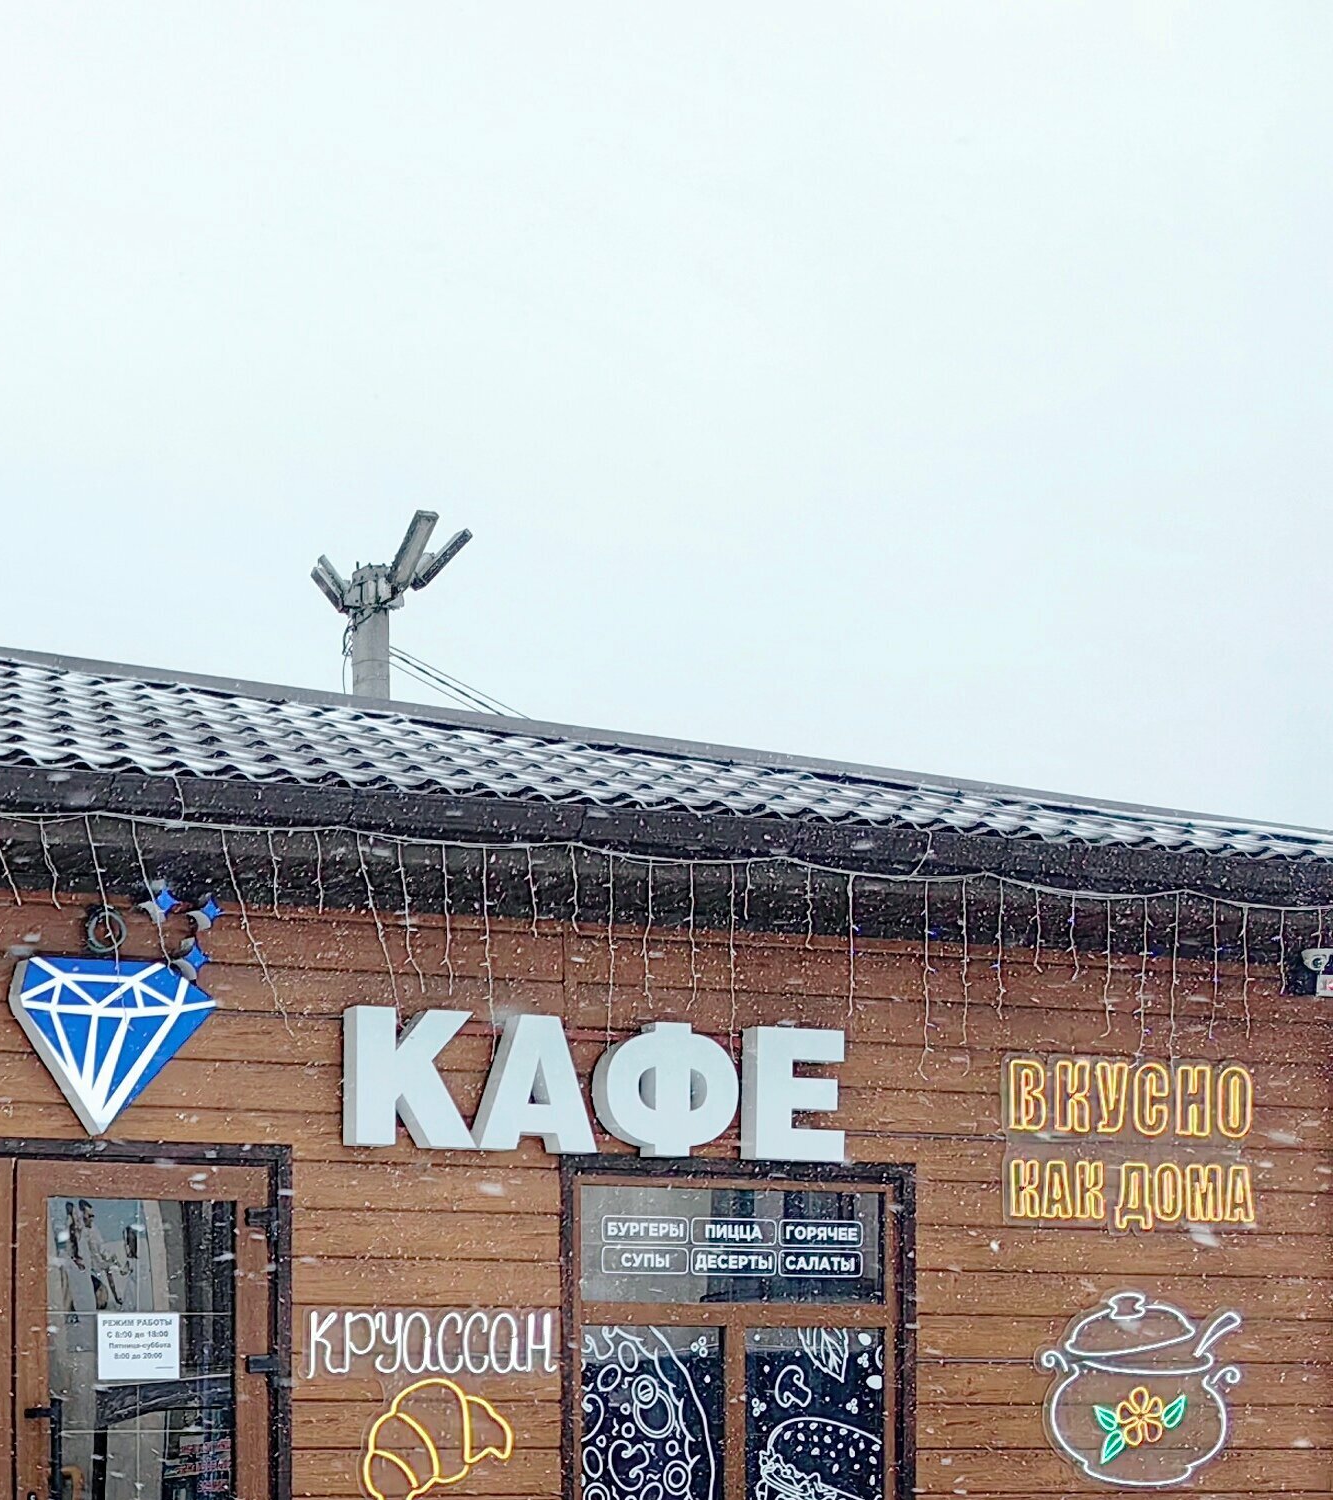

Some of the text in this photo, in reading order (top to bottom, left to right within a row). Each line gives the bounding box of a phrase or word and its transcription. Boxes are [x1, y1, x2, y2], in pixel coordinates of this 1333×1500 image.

[342, 1004, 846, 1163] КАФЕ
[1008, 1059, 1253, 1138] ВКУСНО
[1009, 1159, 1255, 1231] КАК ДОМА
[606, 1221, 684, 1238] БУРГЕРЫ
[704, 1224, 763, 1242] ПИЦЦА
[784, 1226, 859, 1242] ГОРЯЧЕЕ
[620, 1252, 670, 1268] СУПЫ
[694, 1253, 773, 1272] ДЕСЕРТЫ
[784, 1255, 856, 1272] САЛАТЫ
[102, 1319, 173, 1327] РЕЖИМ РАБОТЫ
[143, 1352, 163, 1360] 20:00
